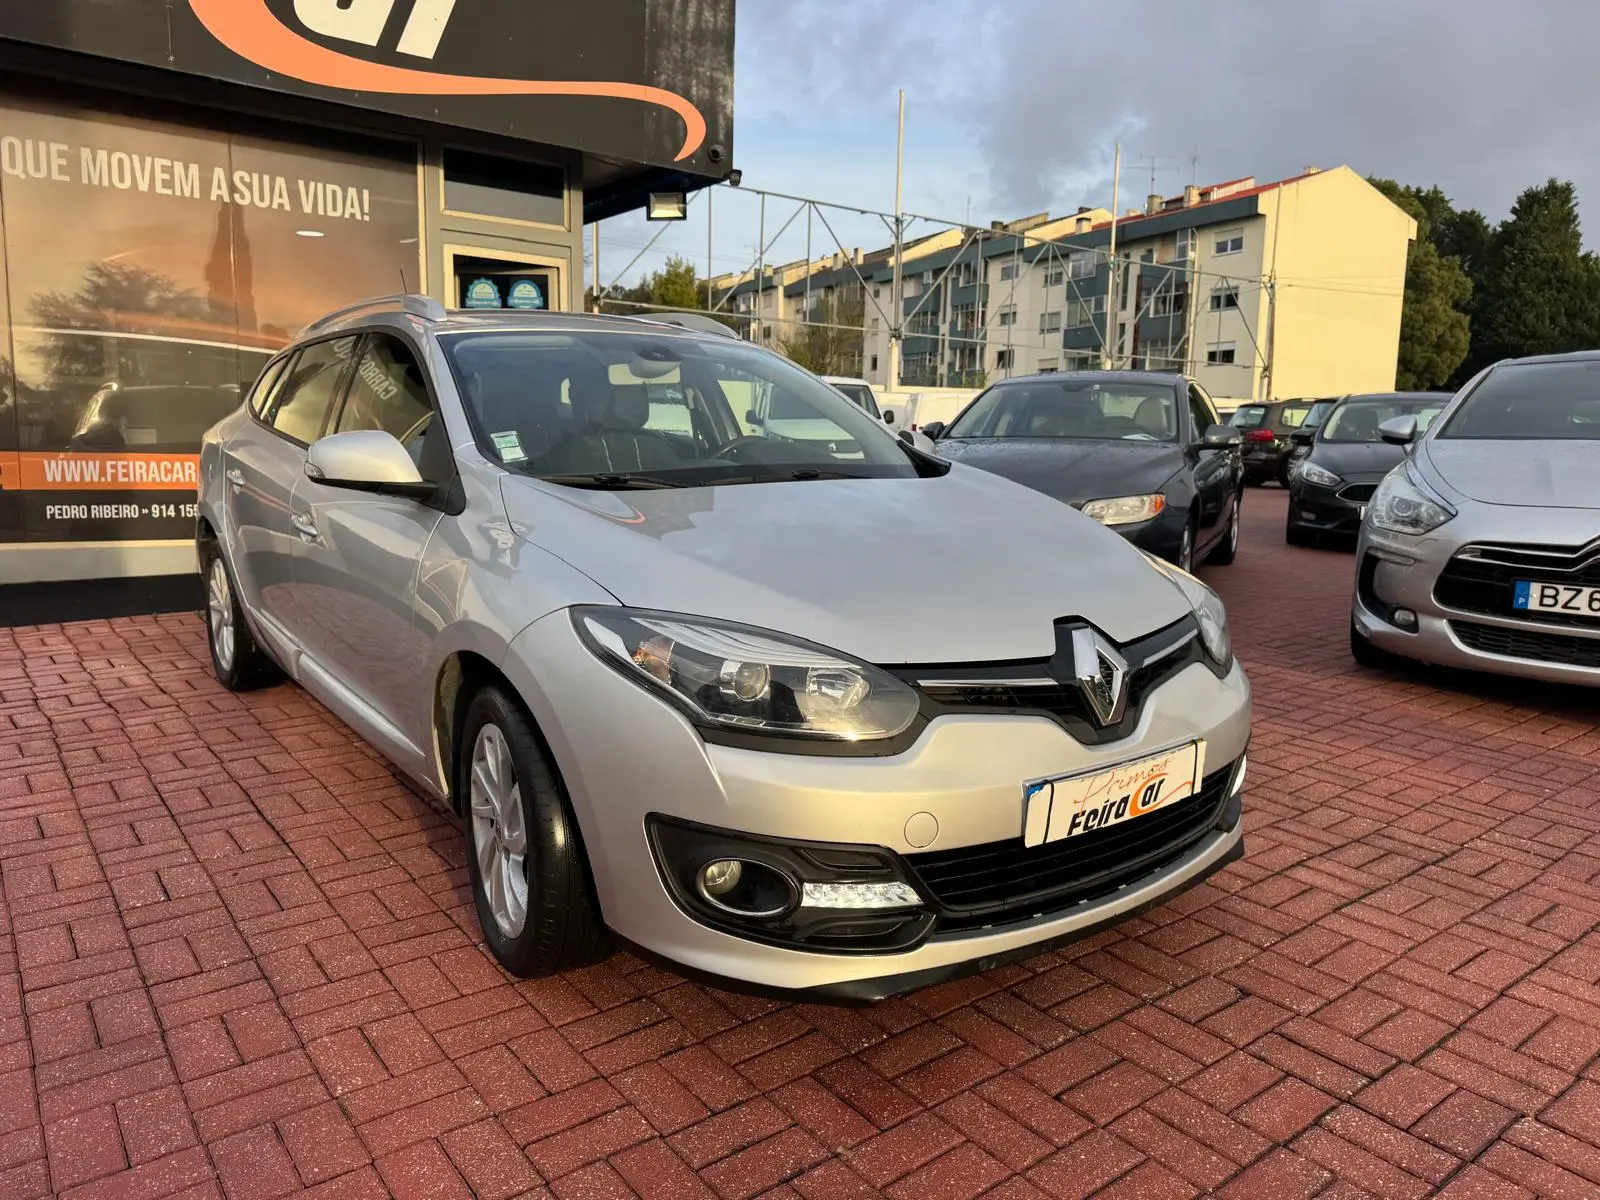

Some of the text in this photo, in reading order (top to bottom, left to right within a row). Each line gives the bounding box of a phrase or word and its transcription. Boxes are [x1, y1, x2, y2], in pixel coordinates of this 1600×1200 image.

[1, 136, 371, 222] QUE MOVEM A SUA VIDA!
[46, 505, 87, 519] PEDRO
[91, 504, 139, 519] RIBEIRO
[151, 503, 176, 518] 914
